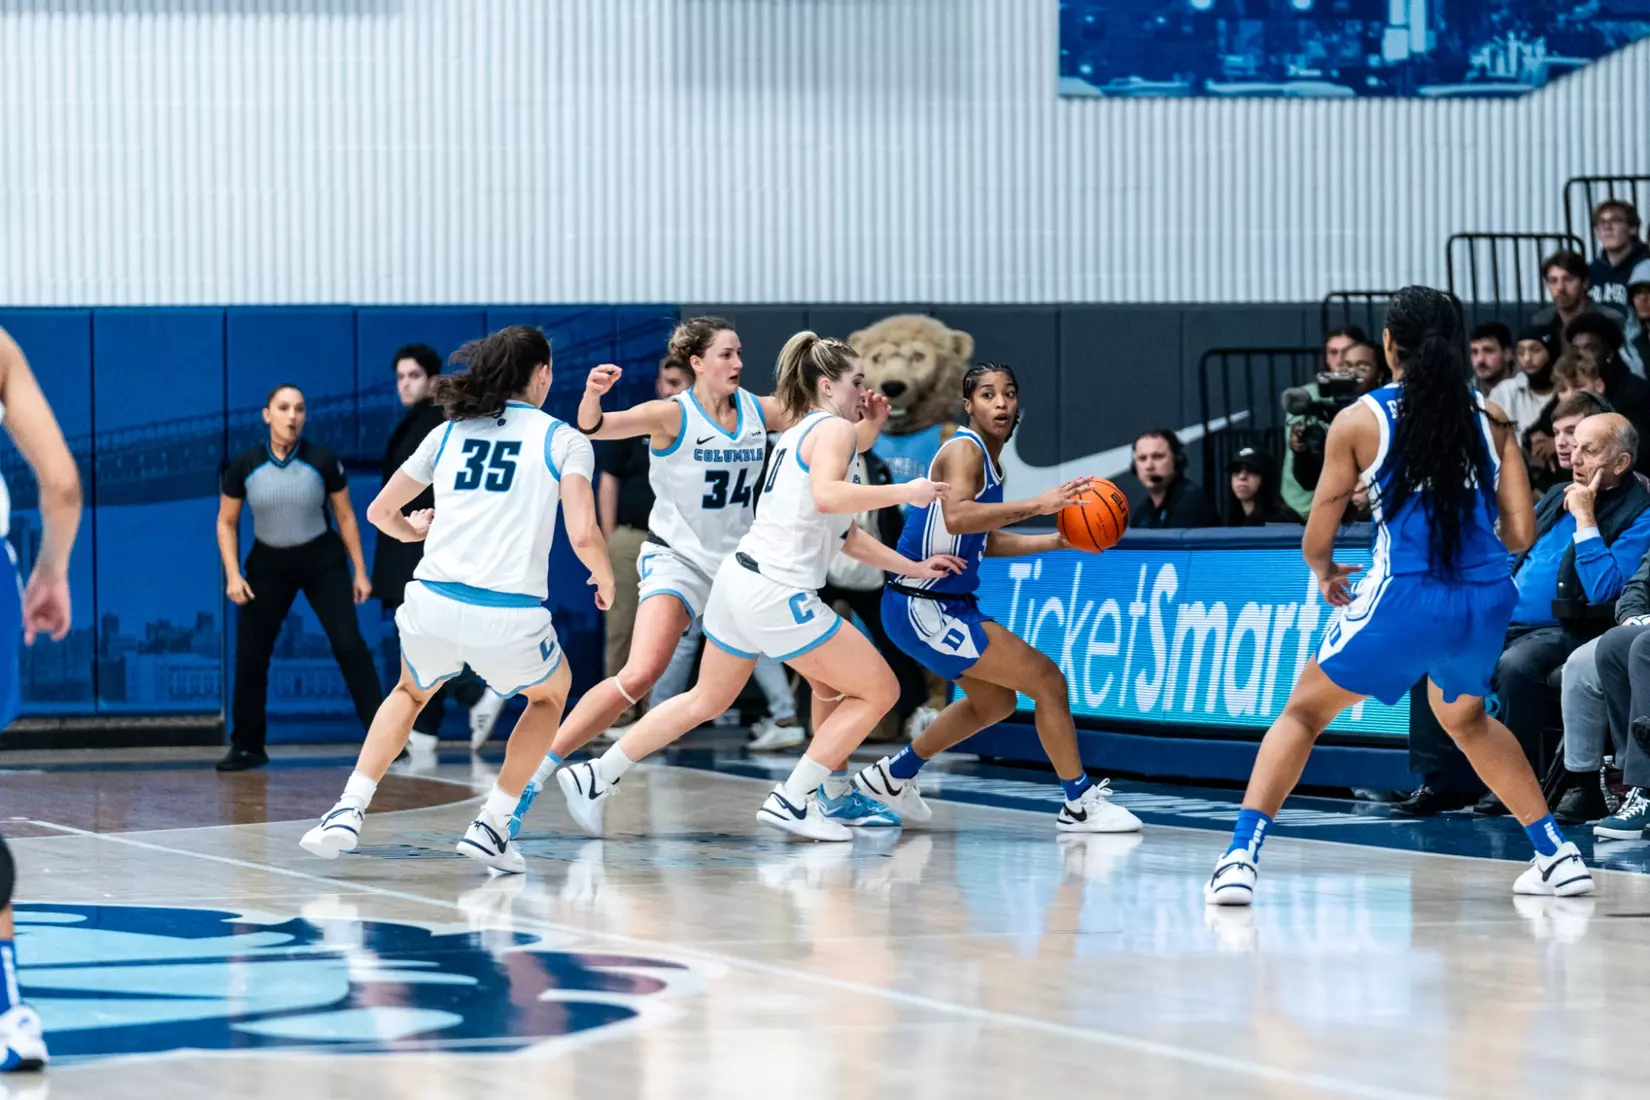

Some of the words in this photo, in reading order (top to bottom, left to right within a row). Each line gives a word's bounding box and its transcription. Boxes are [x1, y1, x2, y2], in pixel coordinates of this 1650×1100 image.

[454, 439, 522, 492] 35
[693, 447, 764, 463] COLUMBIA
[701, 468, 752, 509] 34
[788, 592, 815, 625] C
[942, 628, 966, 652] D
[1009, 559, 1364, 720] TicketSmart
